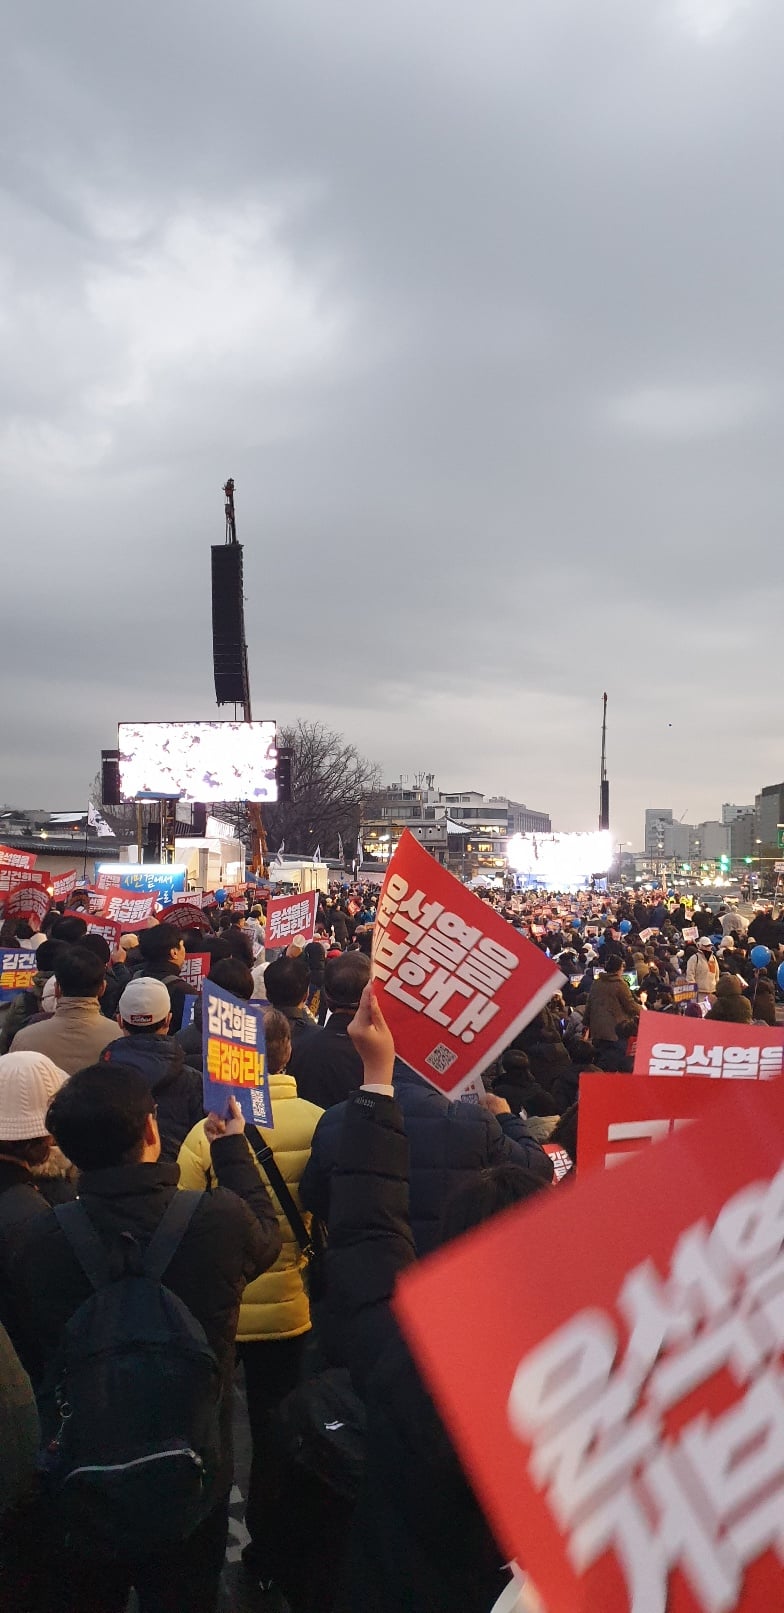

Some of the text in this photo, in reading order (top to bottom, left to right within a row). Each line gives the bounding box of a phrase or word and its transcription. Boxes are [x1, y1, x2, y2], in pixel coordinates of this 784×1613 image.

[108, 896, 154, 914] 윤석열을
[271, 900, 310, 927] 윤석열을
[269, 913, 311, 940] 거부한다!
[376, 873, 519, 998] 윤석열을
[2, 953, 37, 970] 김건
[0, 971, 37, 988] 특검
[207, 995, 257, 1045] 김건희를
[207, 1037, 265, 1086] 특검하라!
